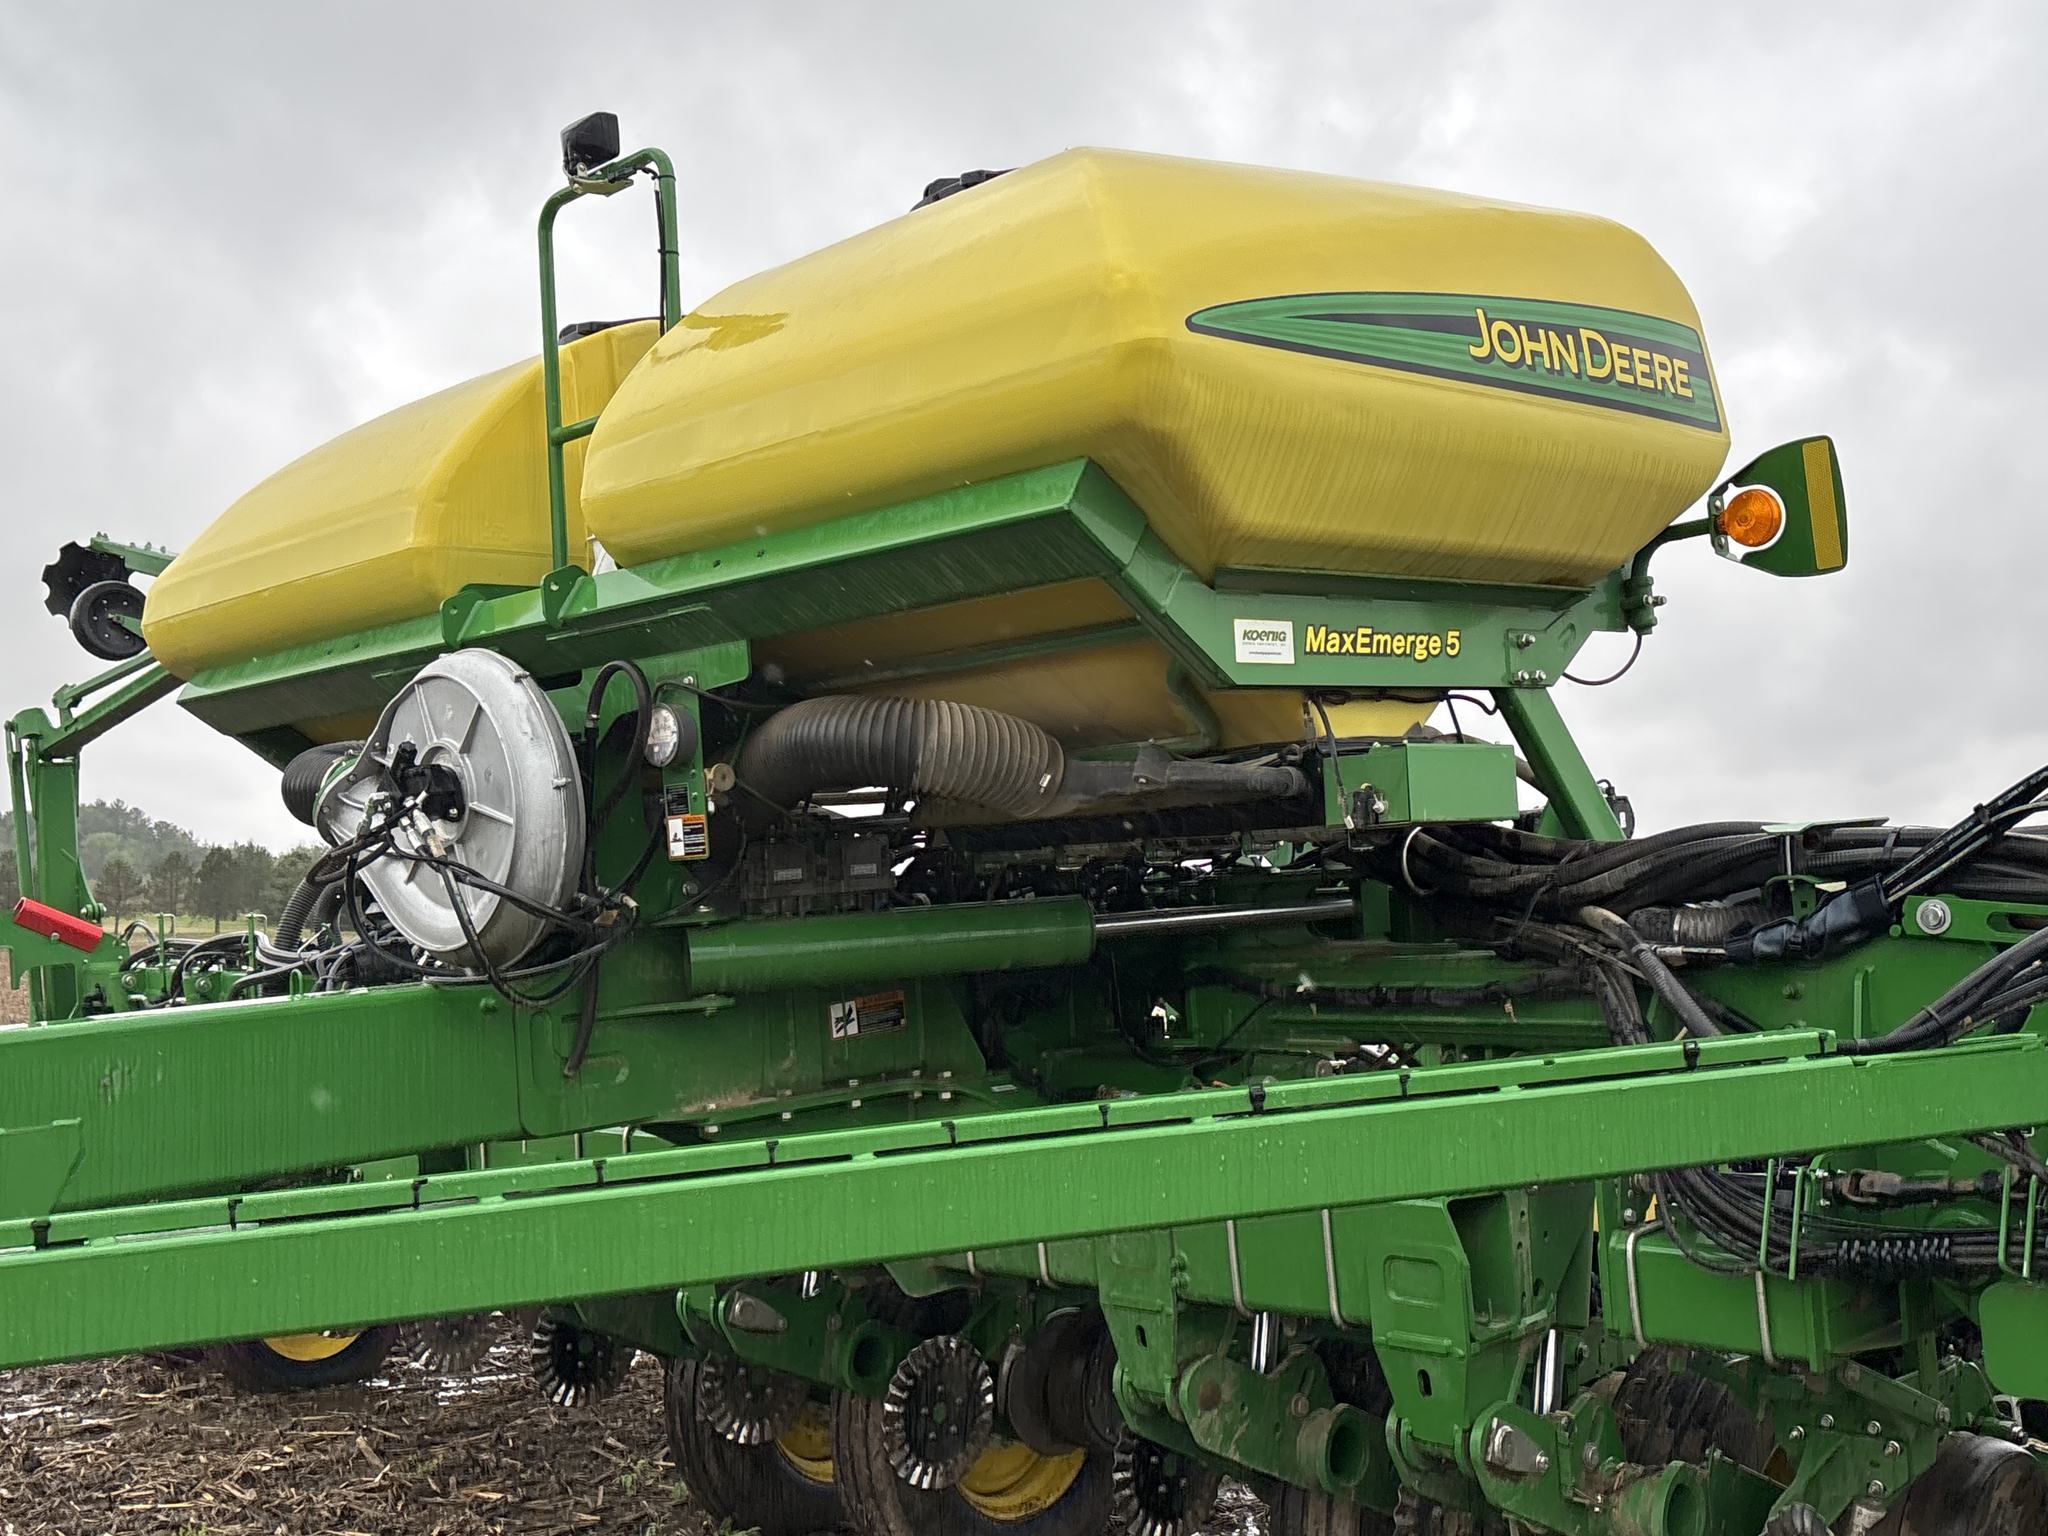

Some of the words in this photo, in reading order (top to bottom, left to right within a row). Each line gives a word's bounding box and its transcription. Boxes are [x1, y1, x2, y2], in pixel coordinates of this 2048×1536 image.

[1469, 308, 1580, 375] JOHN
[1579, 328, 1694, 398] DEERE
[1305, 625, 1442, 661] MaxEmerge
[1445, 630, 1461, 656] 5
